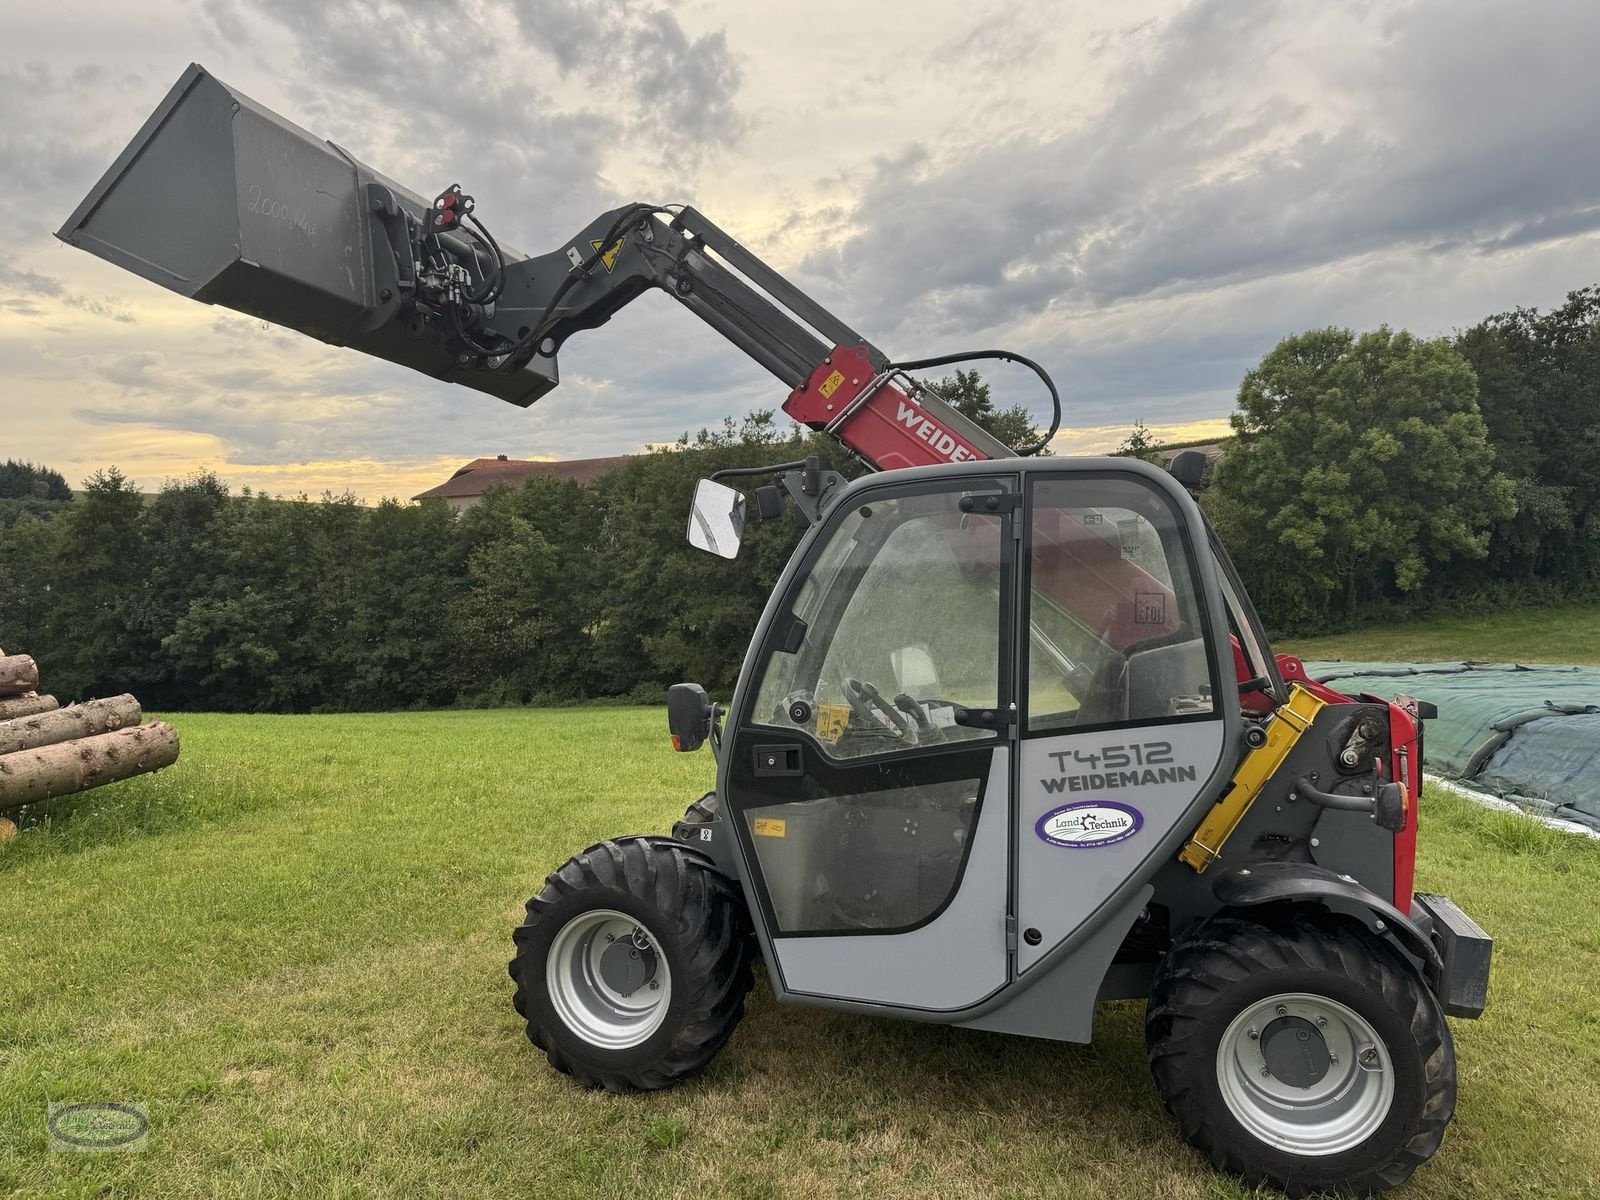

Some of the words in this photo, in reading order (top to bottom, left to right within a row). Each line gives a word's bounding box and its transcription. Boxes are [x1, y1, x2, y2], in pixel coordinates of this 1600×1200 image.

[896, 401, 977, 463] WEIDE
[1048, 741, 1174, 773] T4512
[1040, 765, 1197, 794] WEIDEMANN
[1055, 816, 1080, 828] Land
[1088, 818, 1128, 830] Technik
